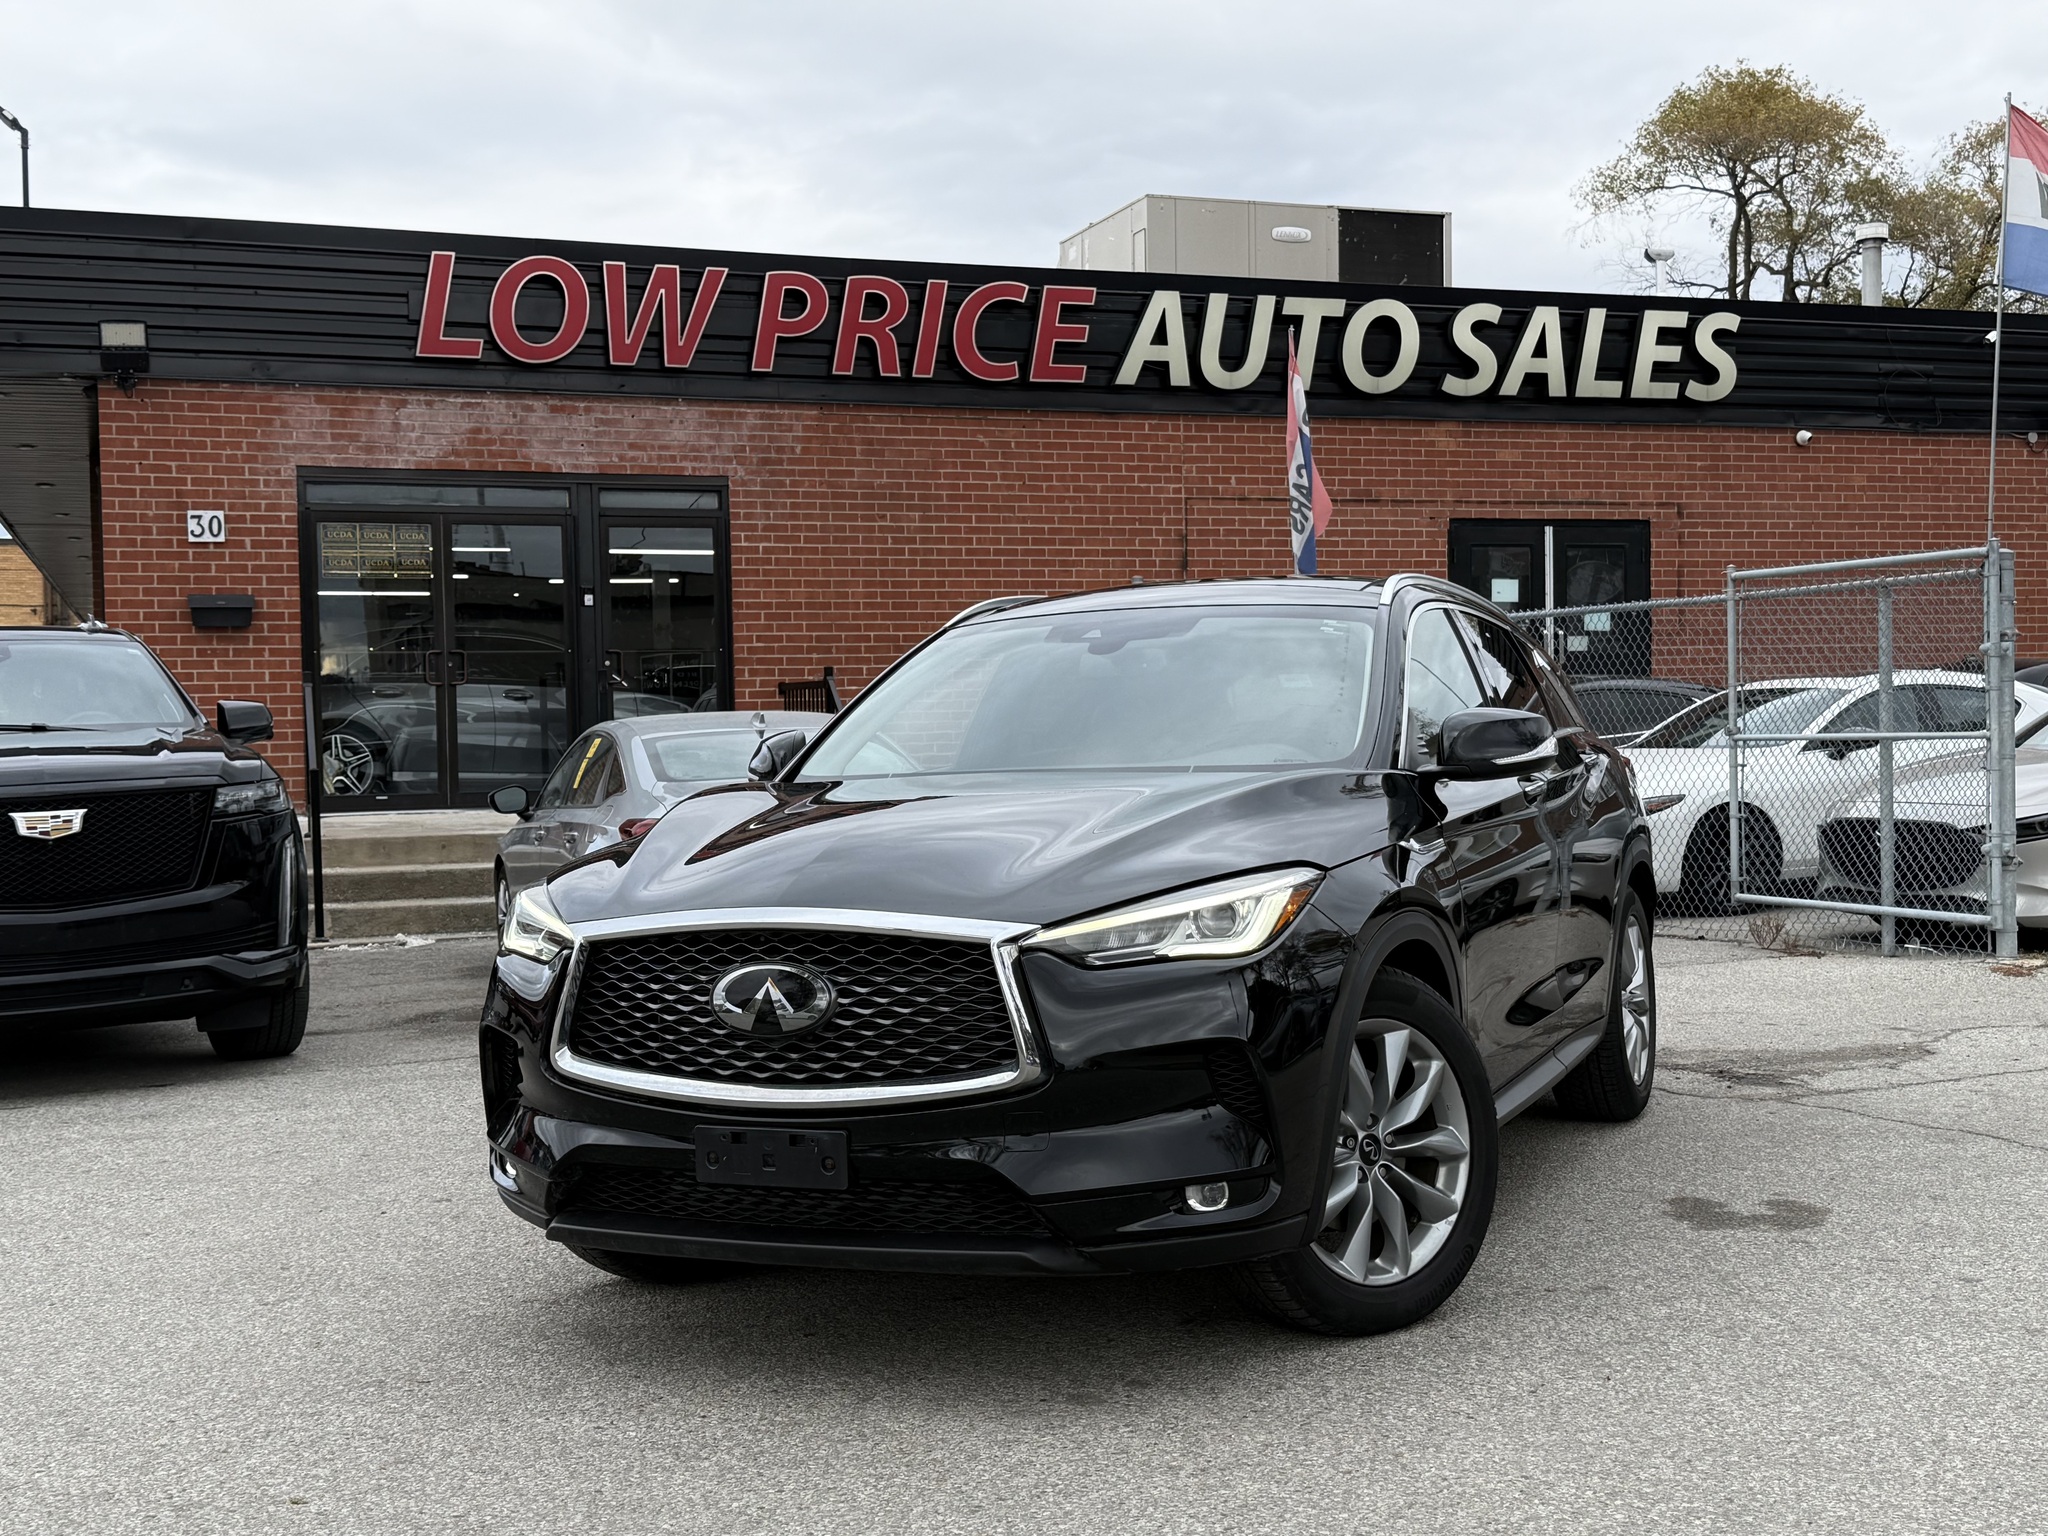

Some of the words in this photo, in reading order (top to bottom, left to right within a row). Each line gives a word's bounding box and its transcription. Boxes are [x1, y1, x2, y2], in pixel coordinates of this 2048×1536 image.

[415, 250, 729, 368] LOW
[750, 271, 1098, 383] PRICE
[1113, 290, 1420, 394] AUTO
[1441, 302, 1742, 402] SALES
[190, 514, 223, 538] 30
[327, 530, 353, 538] UCDA
[363, 531, 389, 539] UCDA
[399, 532, 425, 540] UCDA
[328, 559, 353, 567] UCDA
[364, 559, 390, 567] UCDA
[401, 558, 426, 566] UCDA
